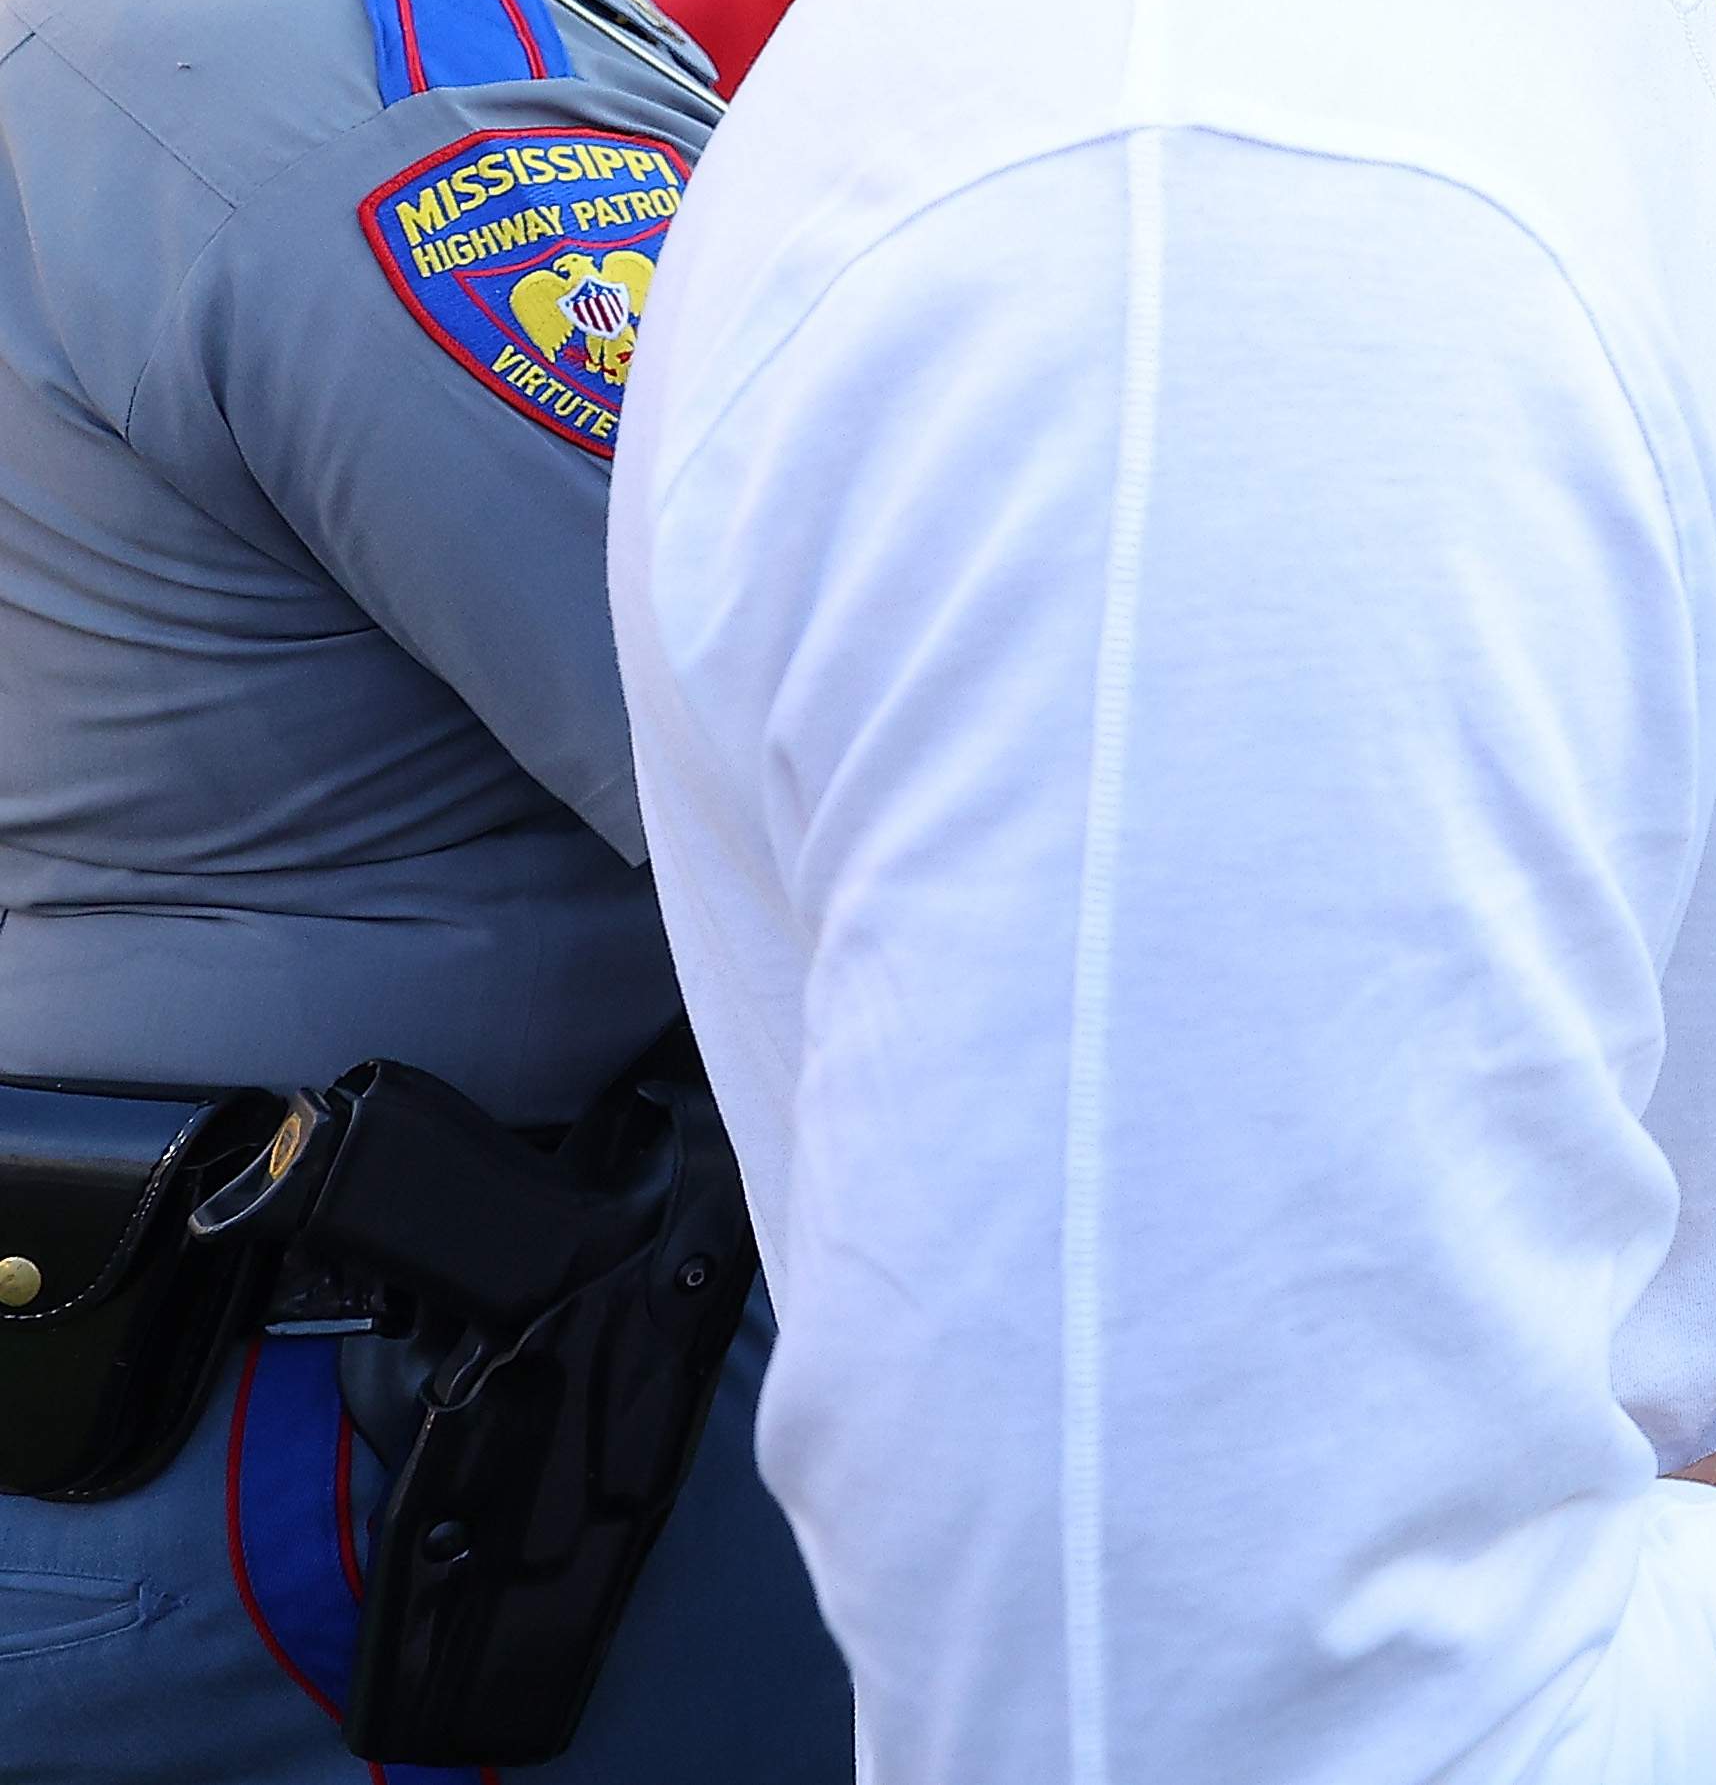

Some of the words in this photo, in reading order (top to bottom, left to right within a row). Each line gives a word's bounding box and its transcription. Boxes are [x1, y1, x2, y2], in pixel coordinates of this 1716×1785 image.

[396, 144, 679, 246] MISSISSIPPI
[412, 205, 565, 278] HIGHWAY
[491, 344, 619, 439] VIRTUTE
